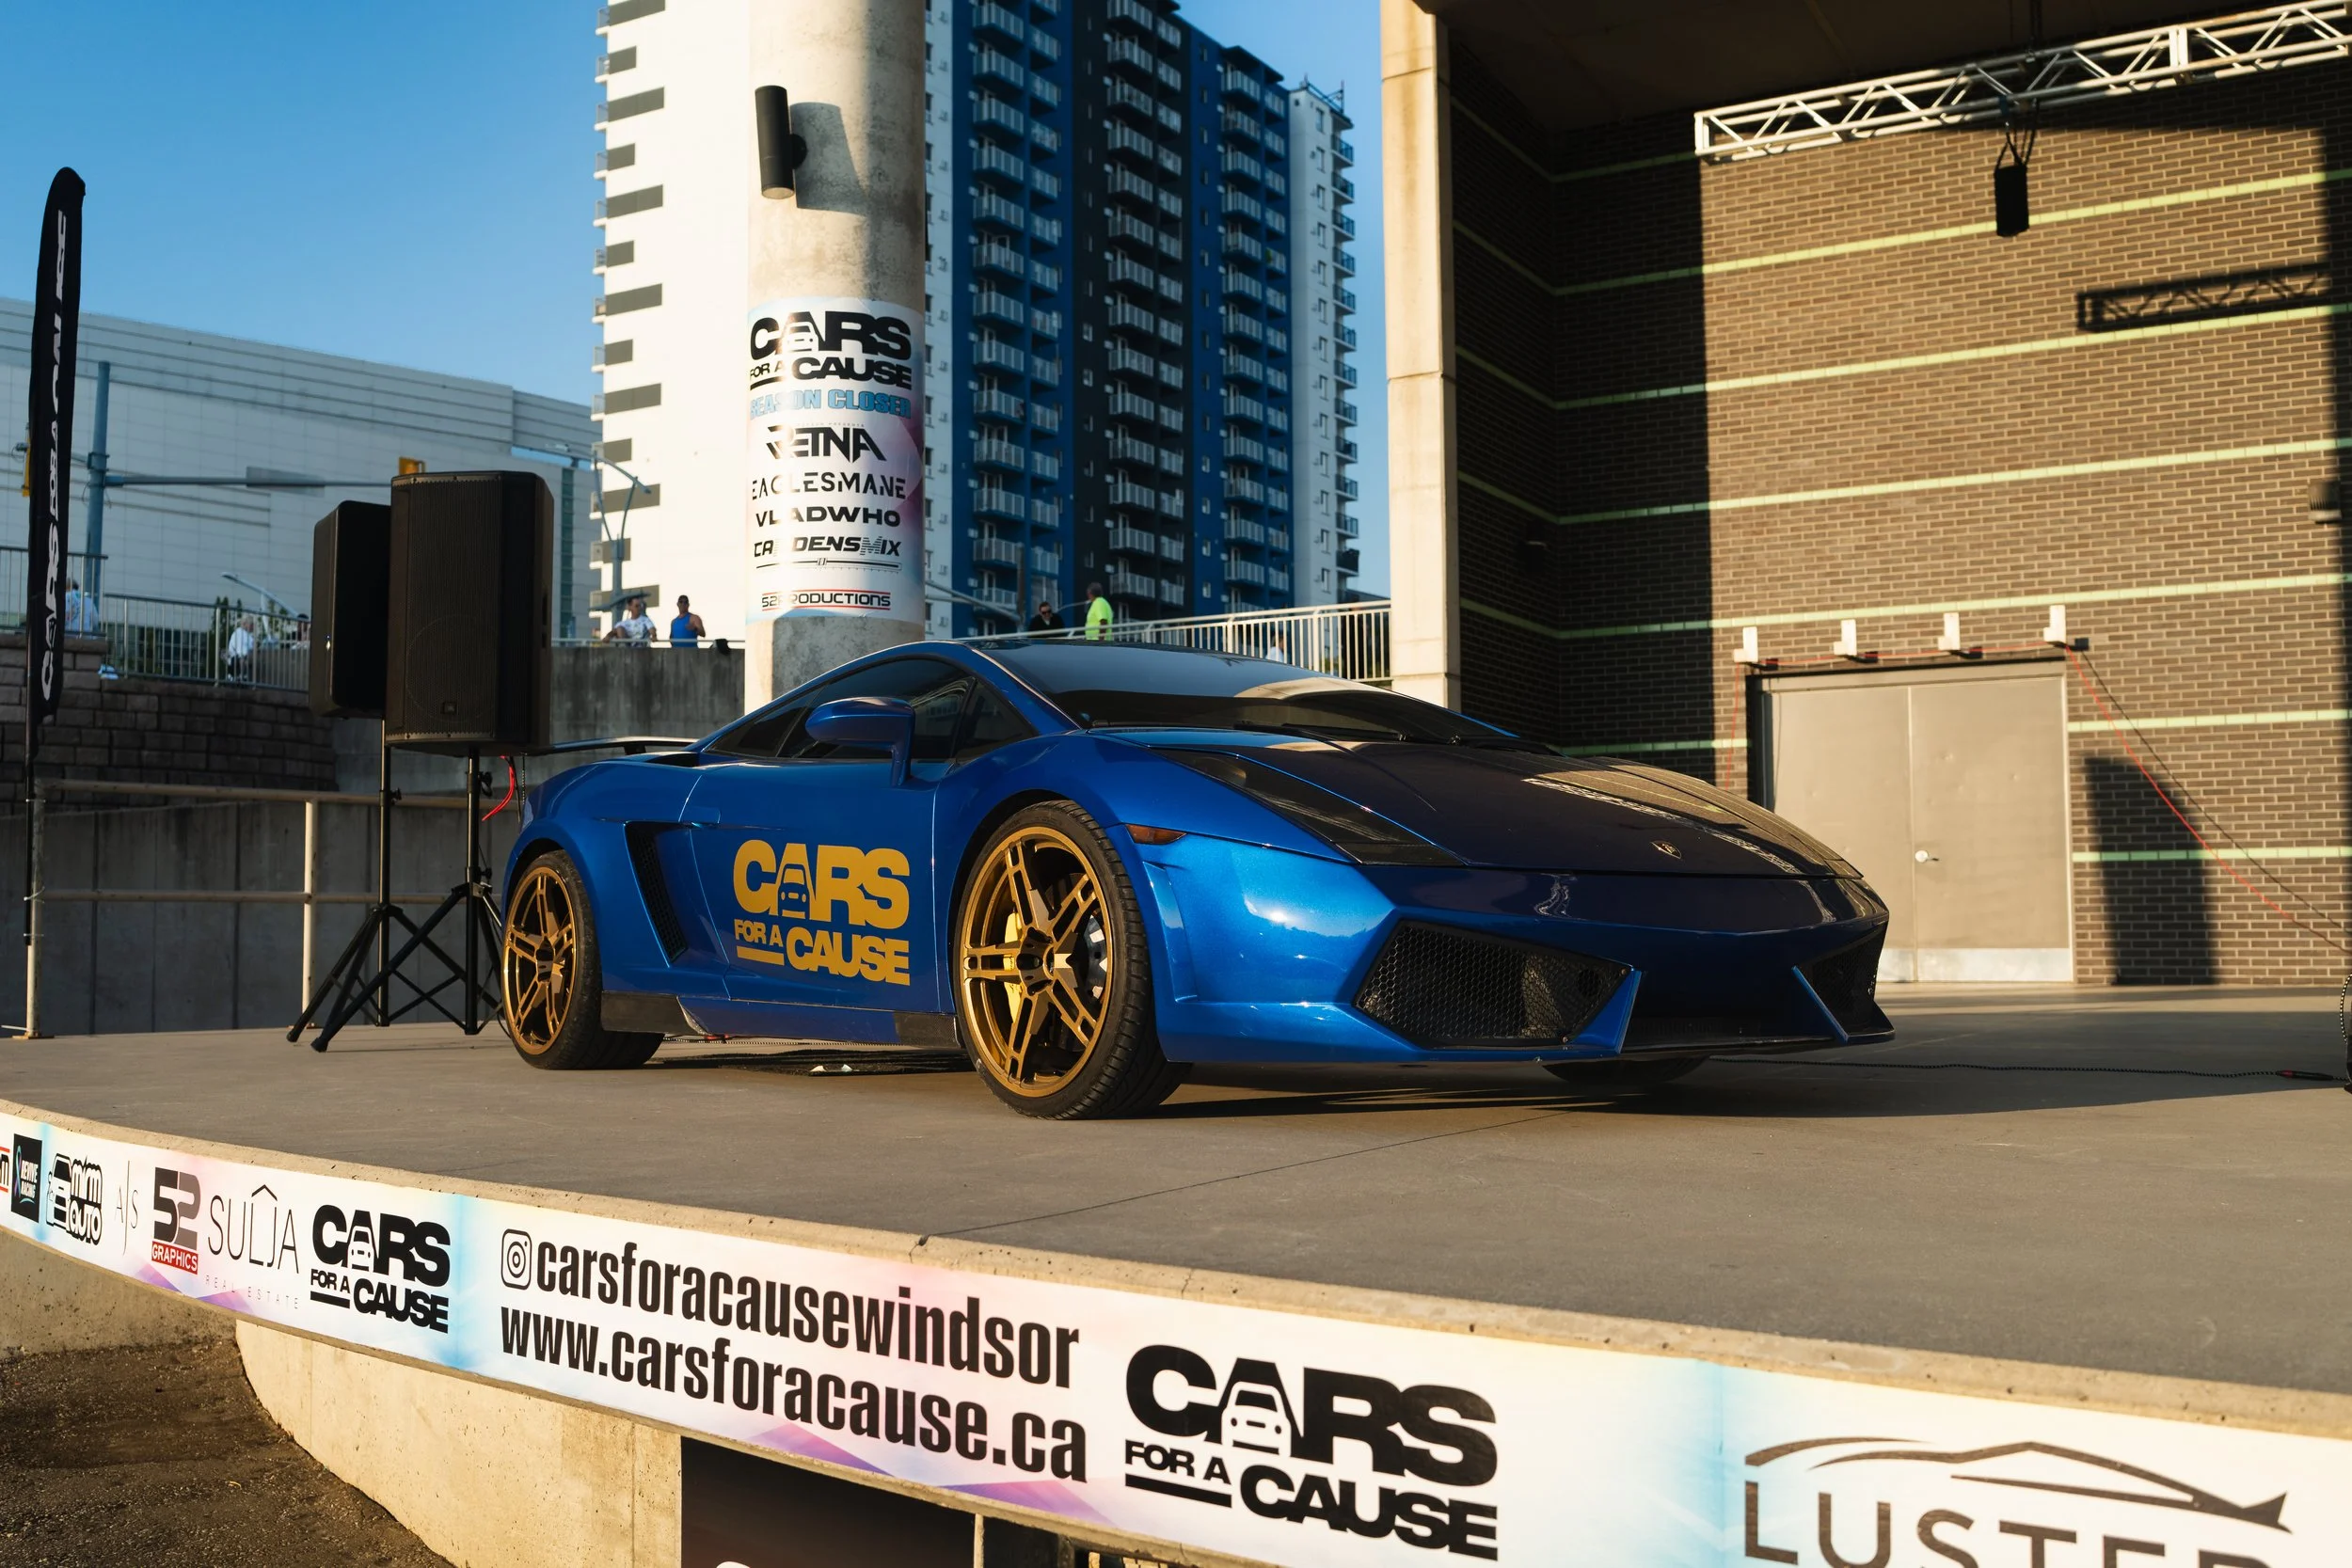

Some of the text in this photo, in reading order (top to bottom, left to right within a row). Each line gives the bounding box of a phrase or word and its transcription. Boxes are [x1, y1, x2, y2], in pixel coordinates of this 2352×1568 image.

[750, 310, 913, 361] CARS
[750, 356, 913, 391] FOR A CAUSE
[828, 388, 912, 420] CLOSER
[755, 506, 901, 528] VLADWHO
[41, 523, 59, 701] CARS
[733, 839, 911, 929] CARS
[734, 918, 911, 986] FOR A CAUSE
[153, 1166, 201, 1251] 52
[312, 1205, 451, 1288] CARS
[152, 1242, 199, 1274] GRAPHICS
[247, 1286, 298, 1309] ESTATE
[310, 1268, 449, 1334] FOR A CAUSE
[536, 1241, 1080, 1389] carsforacausewindsor
[501, 1306, 1089, 1483] www.carsforacause.ca
[1126, 1344, 1498, 1487] CARS
[1125, 1439, 1498, 1561] FOR A CAUSE
[1745, 1481, 2273, 1568] LUST
